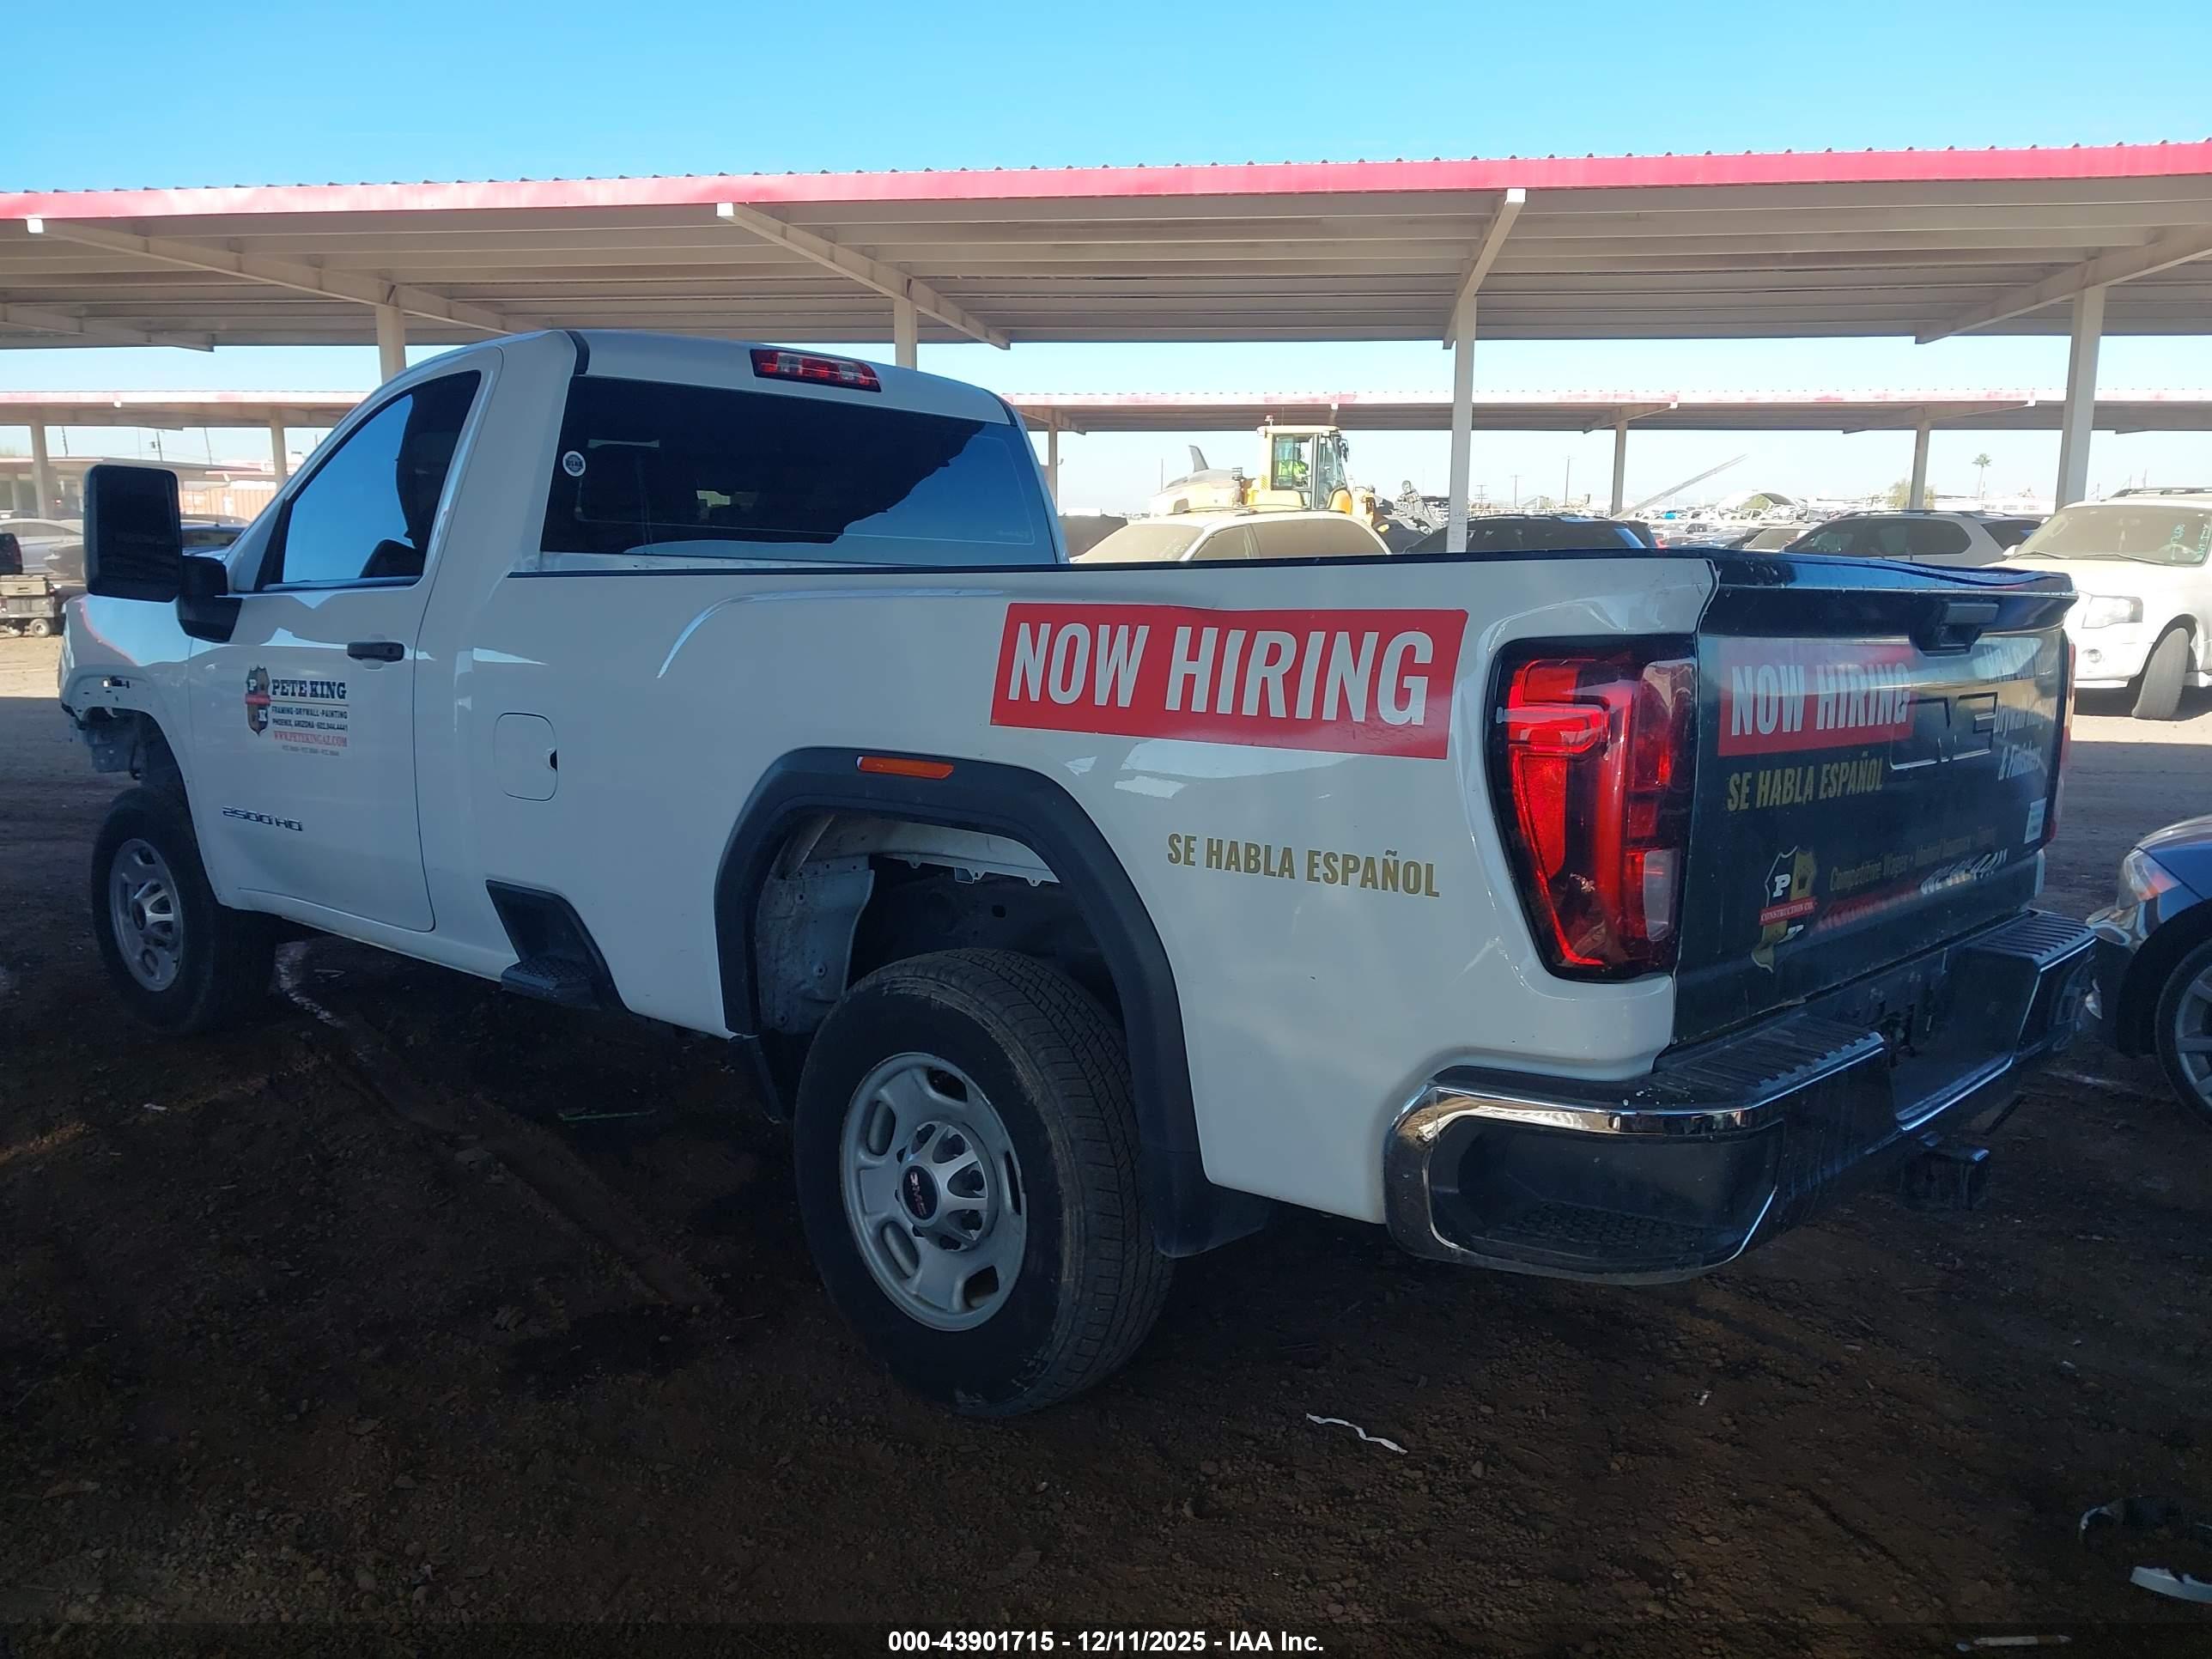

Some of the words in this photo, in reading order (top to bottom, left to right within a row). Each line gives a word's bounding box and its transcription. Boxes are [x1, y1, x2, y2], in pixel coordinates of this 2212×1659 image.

[271, 679, 307, 698] PETE
[309, 680, 347, 700] KING
[1008, 623, 1151, 708] NOW
[1164, 626, 1436, 726] HIRING
[1731, 665, 1807, 736] NOW
[1815, 662, 1911, 731] HIRING
[1727, 771, 1753, 811] SE
[1756, 765, 1814, 809] HABLA
[1818, 750, 1883, 800] ESPAÑOL
[222, 805, 273, 826] 2500
[275, 816, 303, 832] HD
[1167, 833, 1197, 866] SE
[1206, 837, 1296, 879] HABLA
[1305, 848, 1441, 898] ESPAÑOL
[1772, 873, 1792, 898] P
